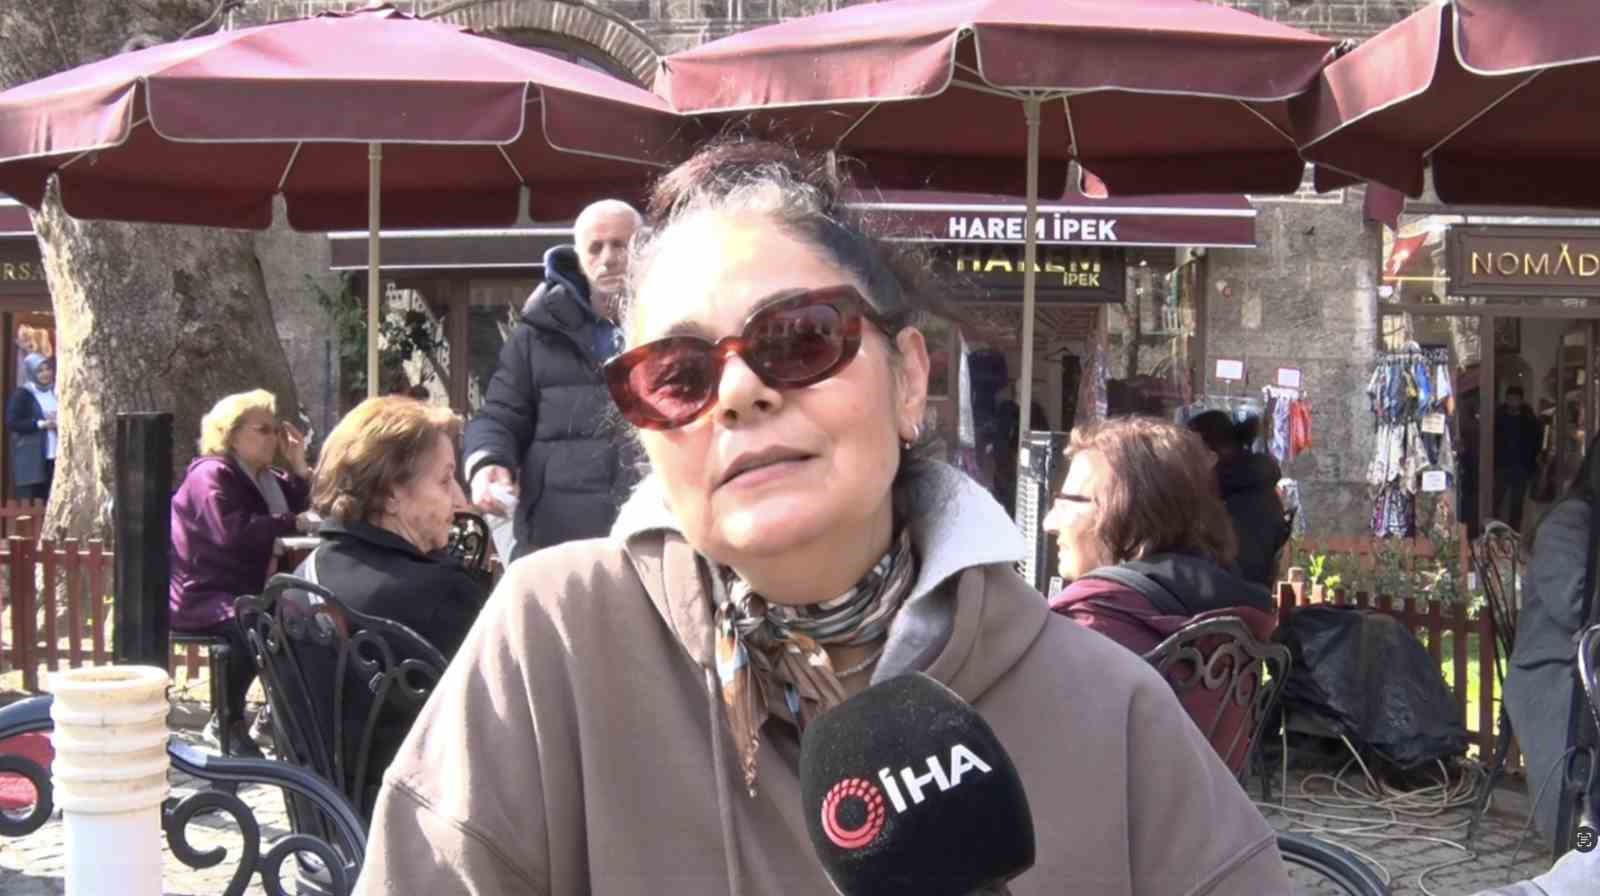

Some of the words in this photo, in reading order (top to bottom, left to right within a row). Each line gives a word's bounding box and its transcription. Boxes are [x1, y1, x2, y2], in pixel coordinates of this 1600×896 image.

[949, 217, 1045, 239] HAREM
[1053, 213, 1118, 241] İPEK
[1063, 272, 1100, 287] İPEK
[878, 744, 992, 813] İHA
